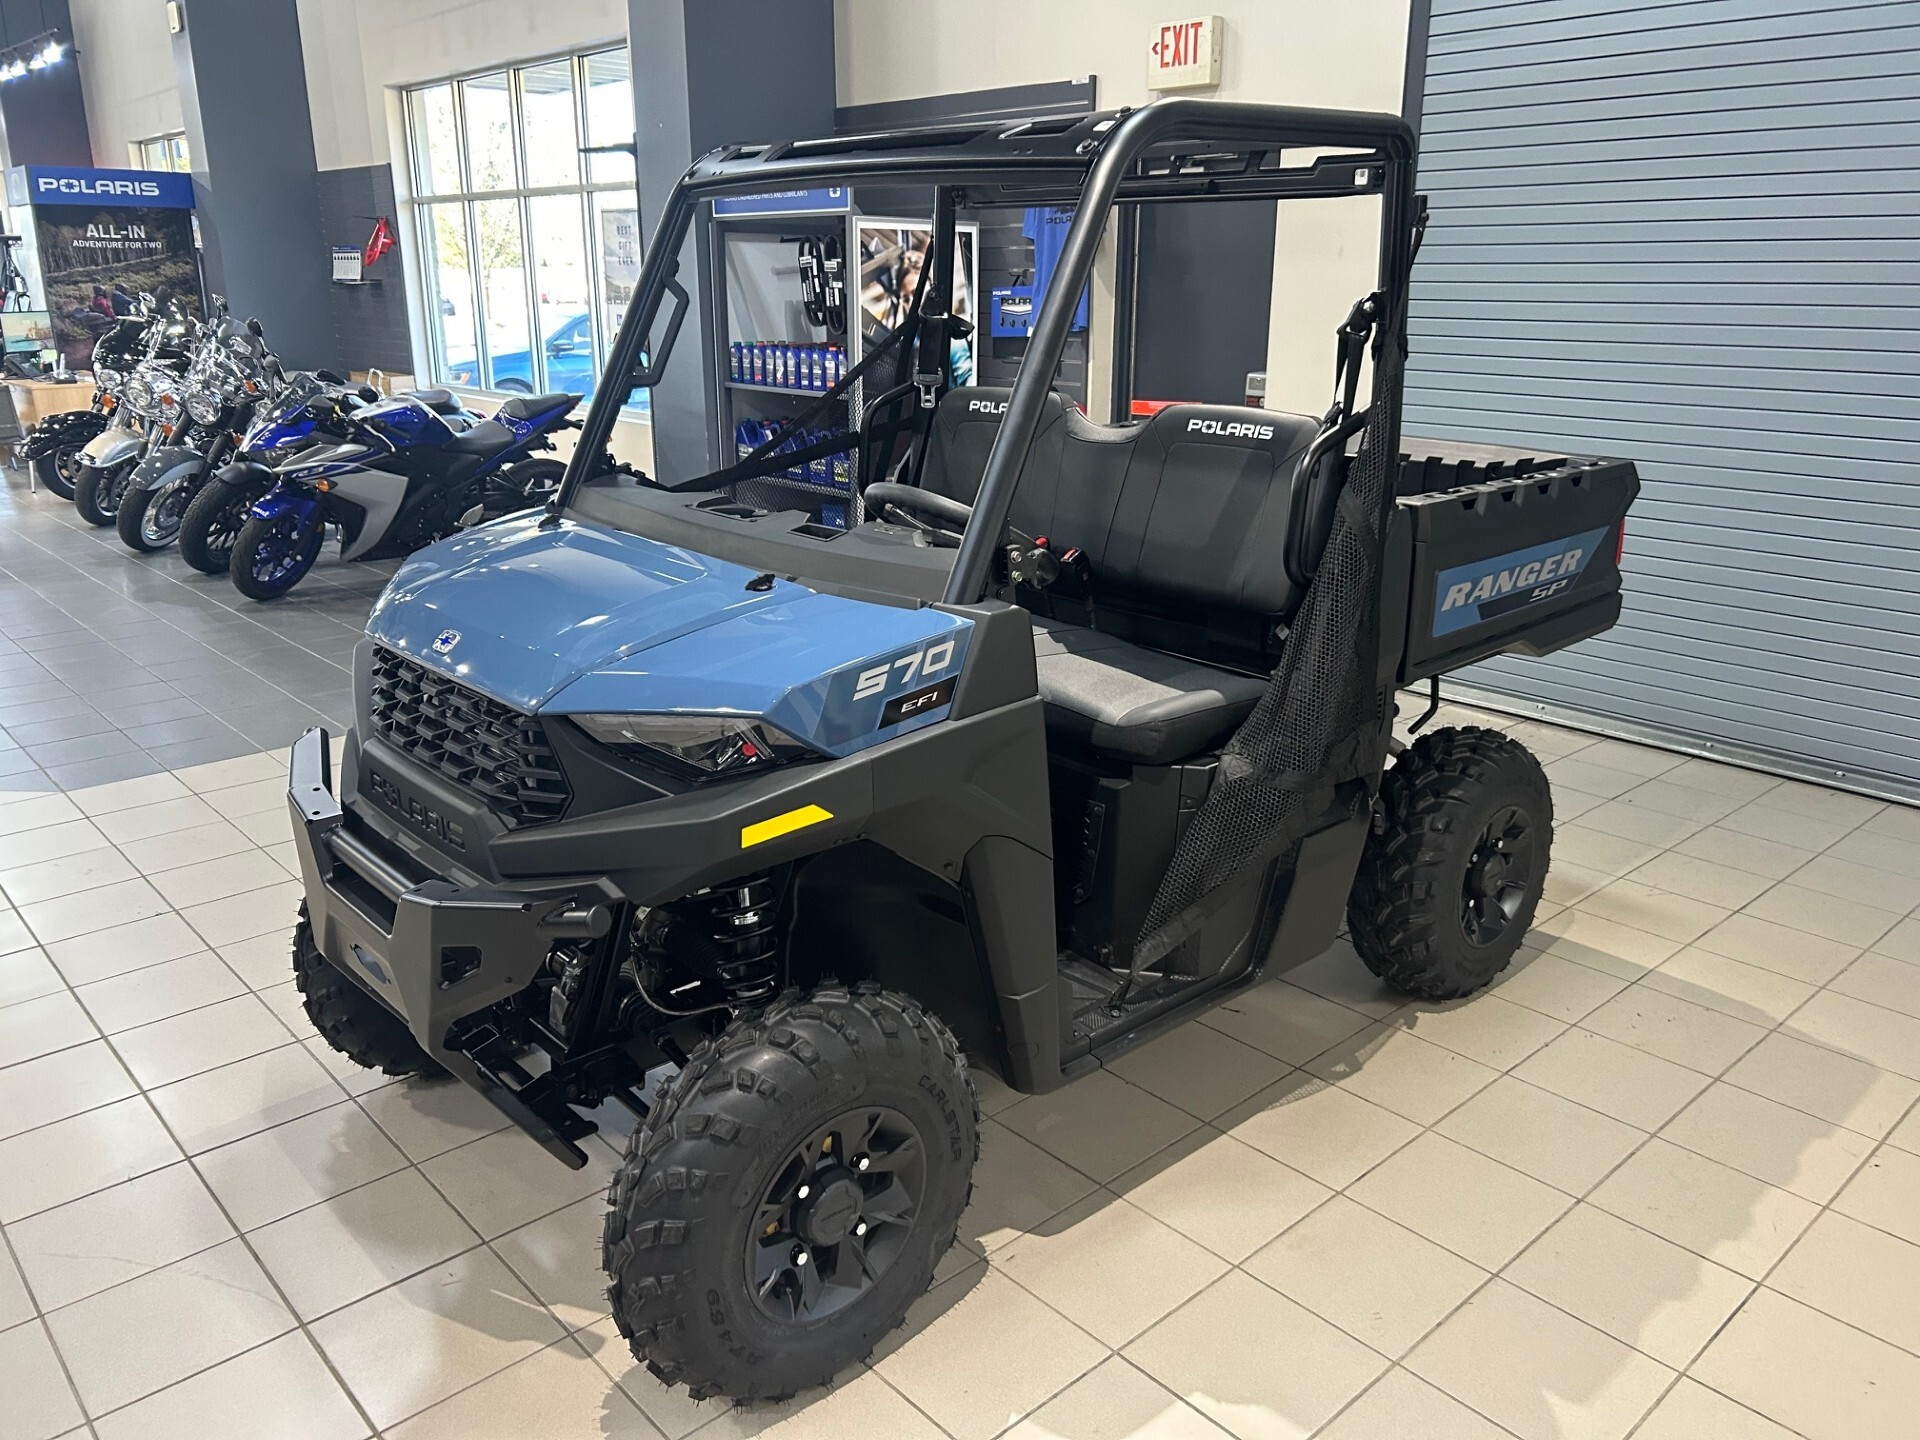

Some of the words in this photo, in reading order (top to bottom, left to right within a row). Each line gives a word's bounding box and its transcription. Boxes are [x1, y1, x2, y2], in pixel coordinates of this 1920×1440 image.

[1160, 21, 1203, 68] EXIT
[37, 177, 160, 196] POLARIS
[1046, 215, 1072, 225] POLA
[86, 223, 146, 239] ALL-IN
[72, 239, 124, 249] ADVENTURE
[125, 240, 142, 249] FOR
[143, 241, 162, 249] TWO
[1001, 297, 1032, 306] POLAR
[969, 400, 1008, 414] POLA
[1186, 419, 1275, 440] POLARIS
[1440, 548, 1583, 612] RANGER
[1528, 578, 1569, 602] SP
[852, 640, 955, 701] 570
[900, 691, 939, 713] EFI
[369, 768, 466, 852] POLARIS
[918, 1074, 962, 1161] CARLSTAR
